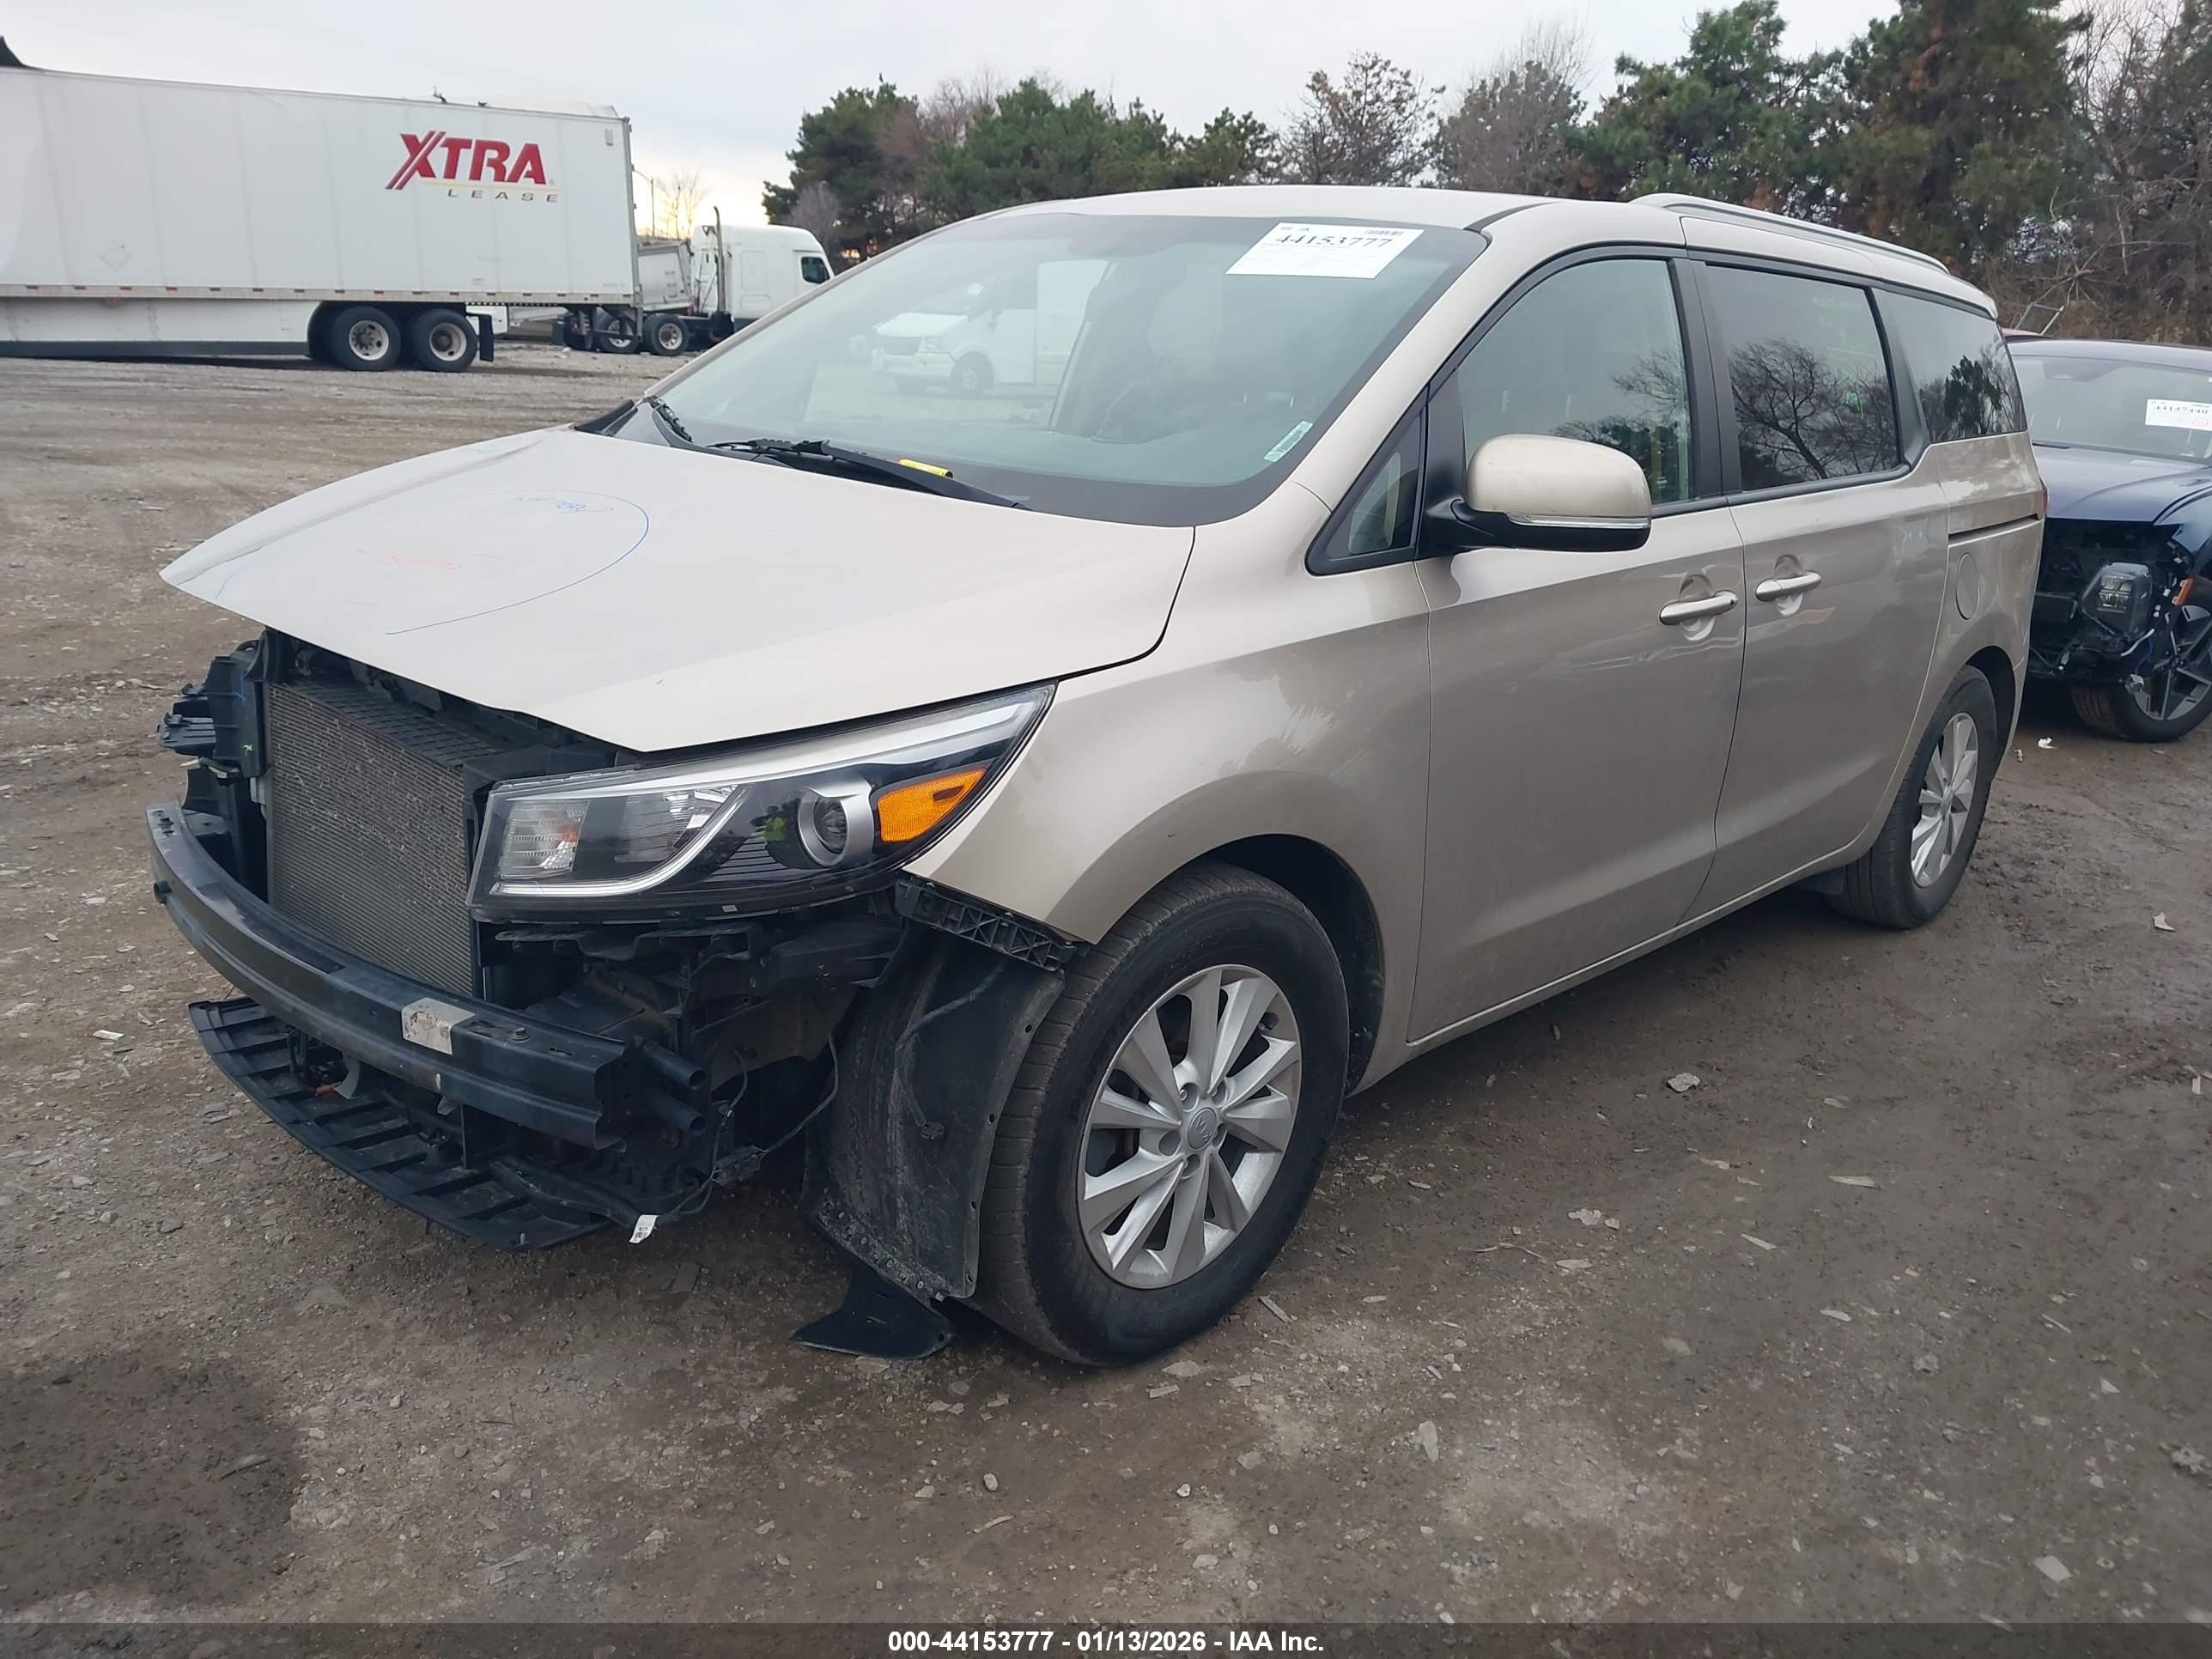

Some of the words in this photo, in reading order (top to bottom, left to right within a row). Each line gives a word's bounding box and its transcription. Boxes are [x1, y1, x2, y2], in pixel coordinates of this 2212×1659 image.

[385, 131, 547, 191] XTRA
[447, 188, 559, 204] LEASE
[1275, 234, 1394, 247] 44153777
